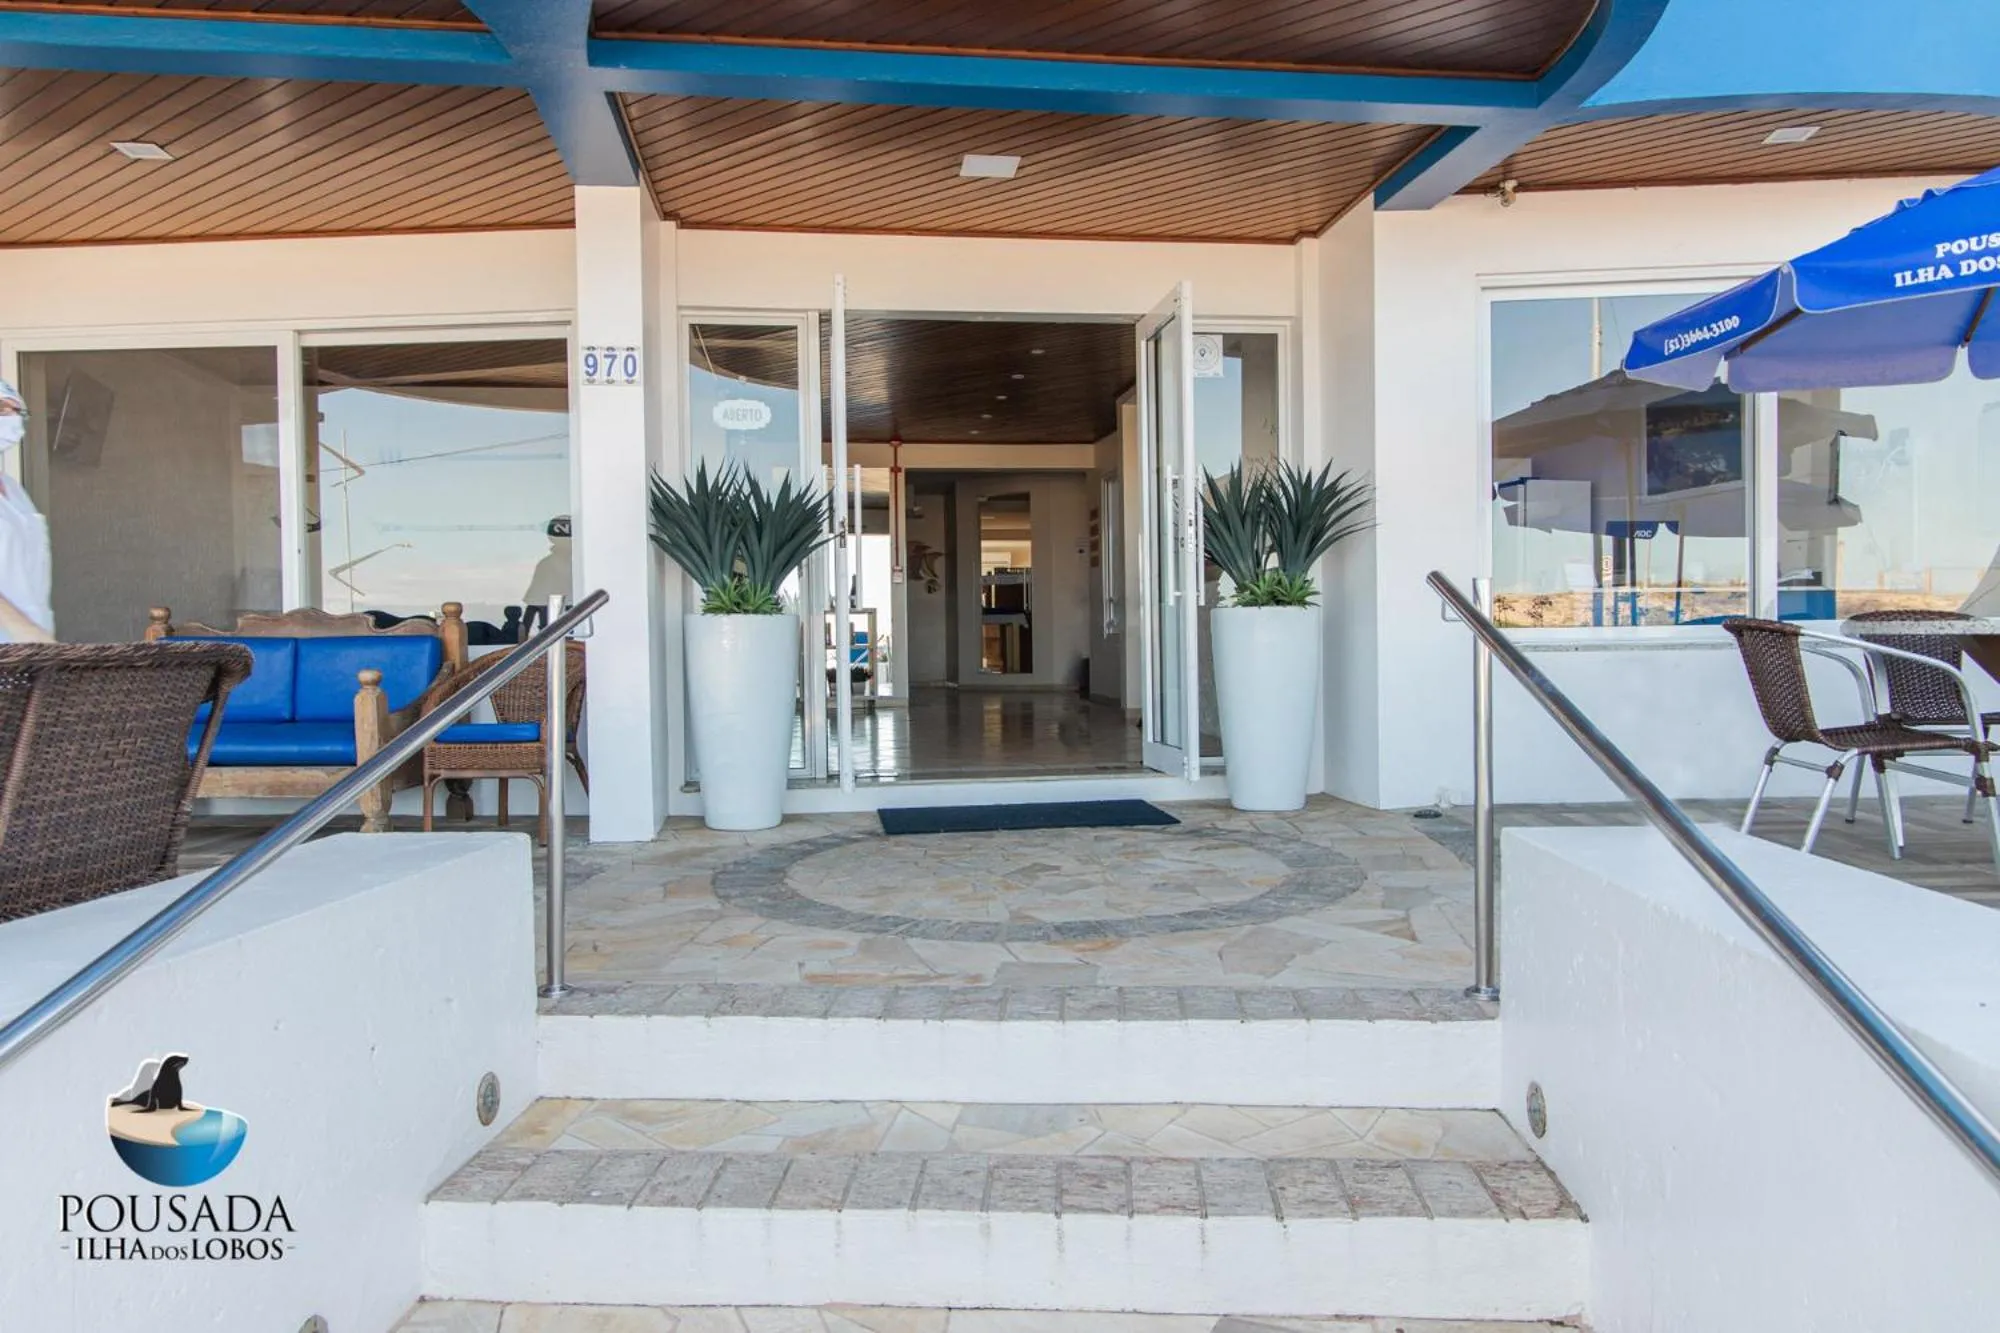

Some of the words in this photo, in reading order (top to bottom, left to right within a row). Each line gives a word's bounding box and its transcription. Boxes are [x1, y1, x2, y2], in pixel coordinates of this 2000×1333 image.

[1894, 263, 1955, 288] ILHA
[1959, 255, 2000, 276] DO
[584, 353, 637, 378] 970
[722, 407, 763, 421] ABERTO
